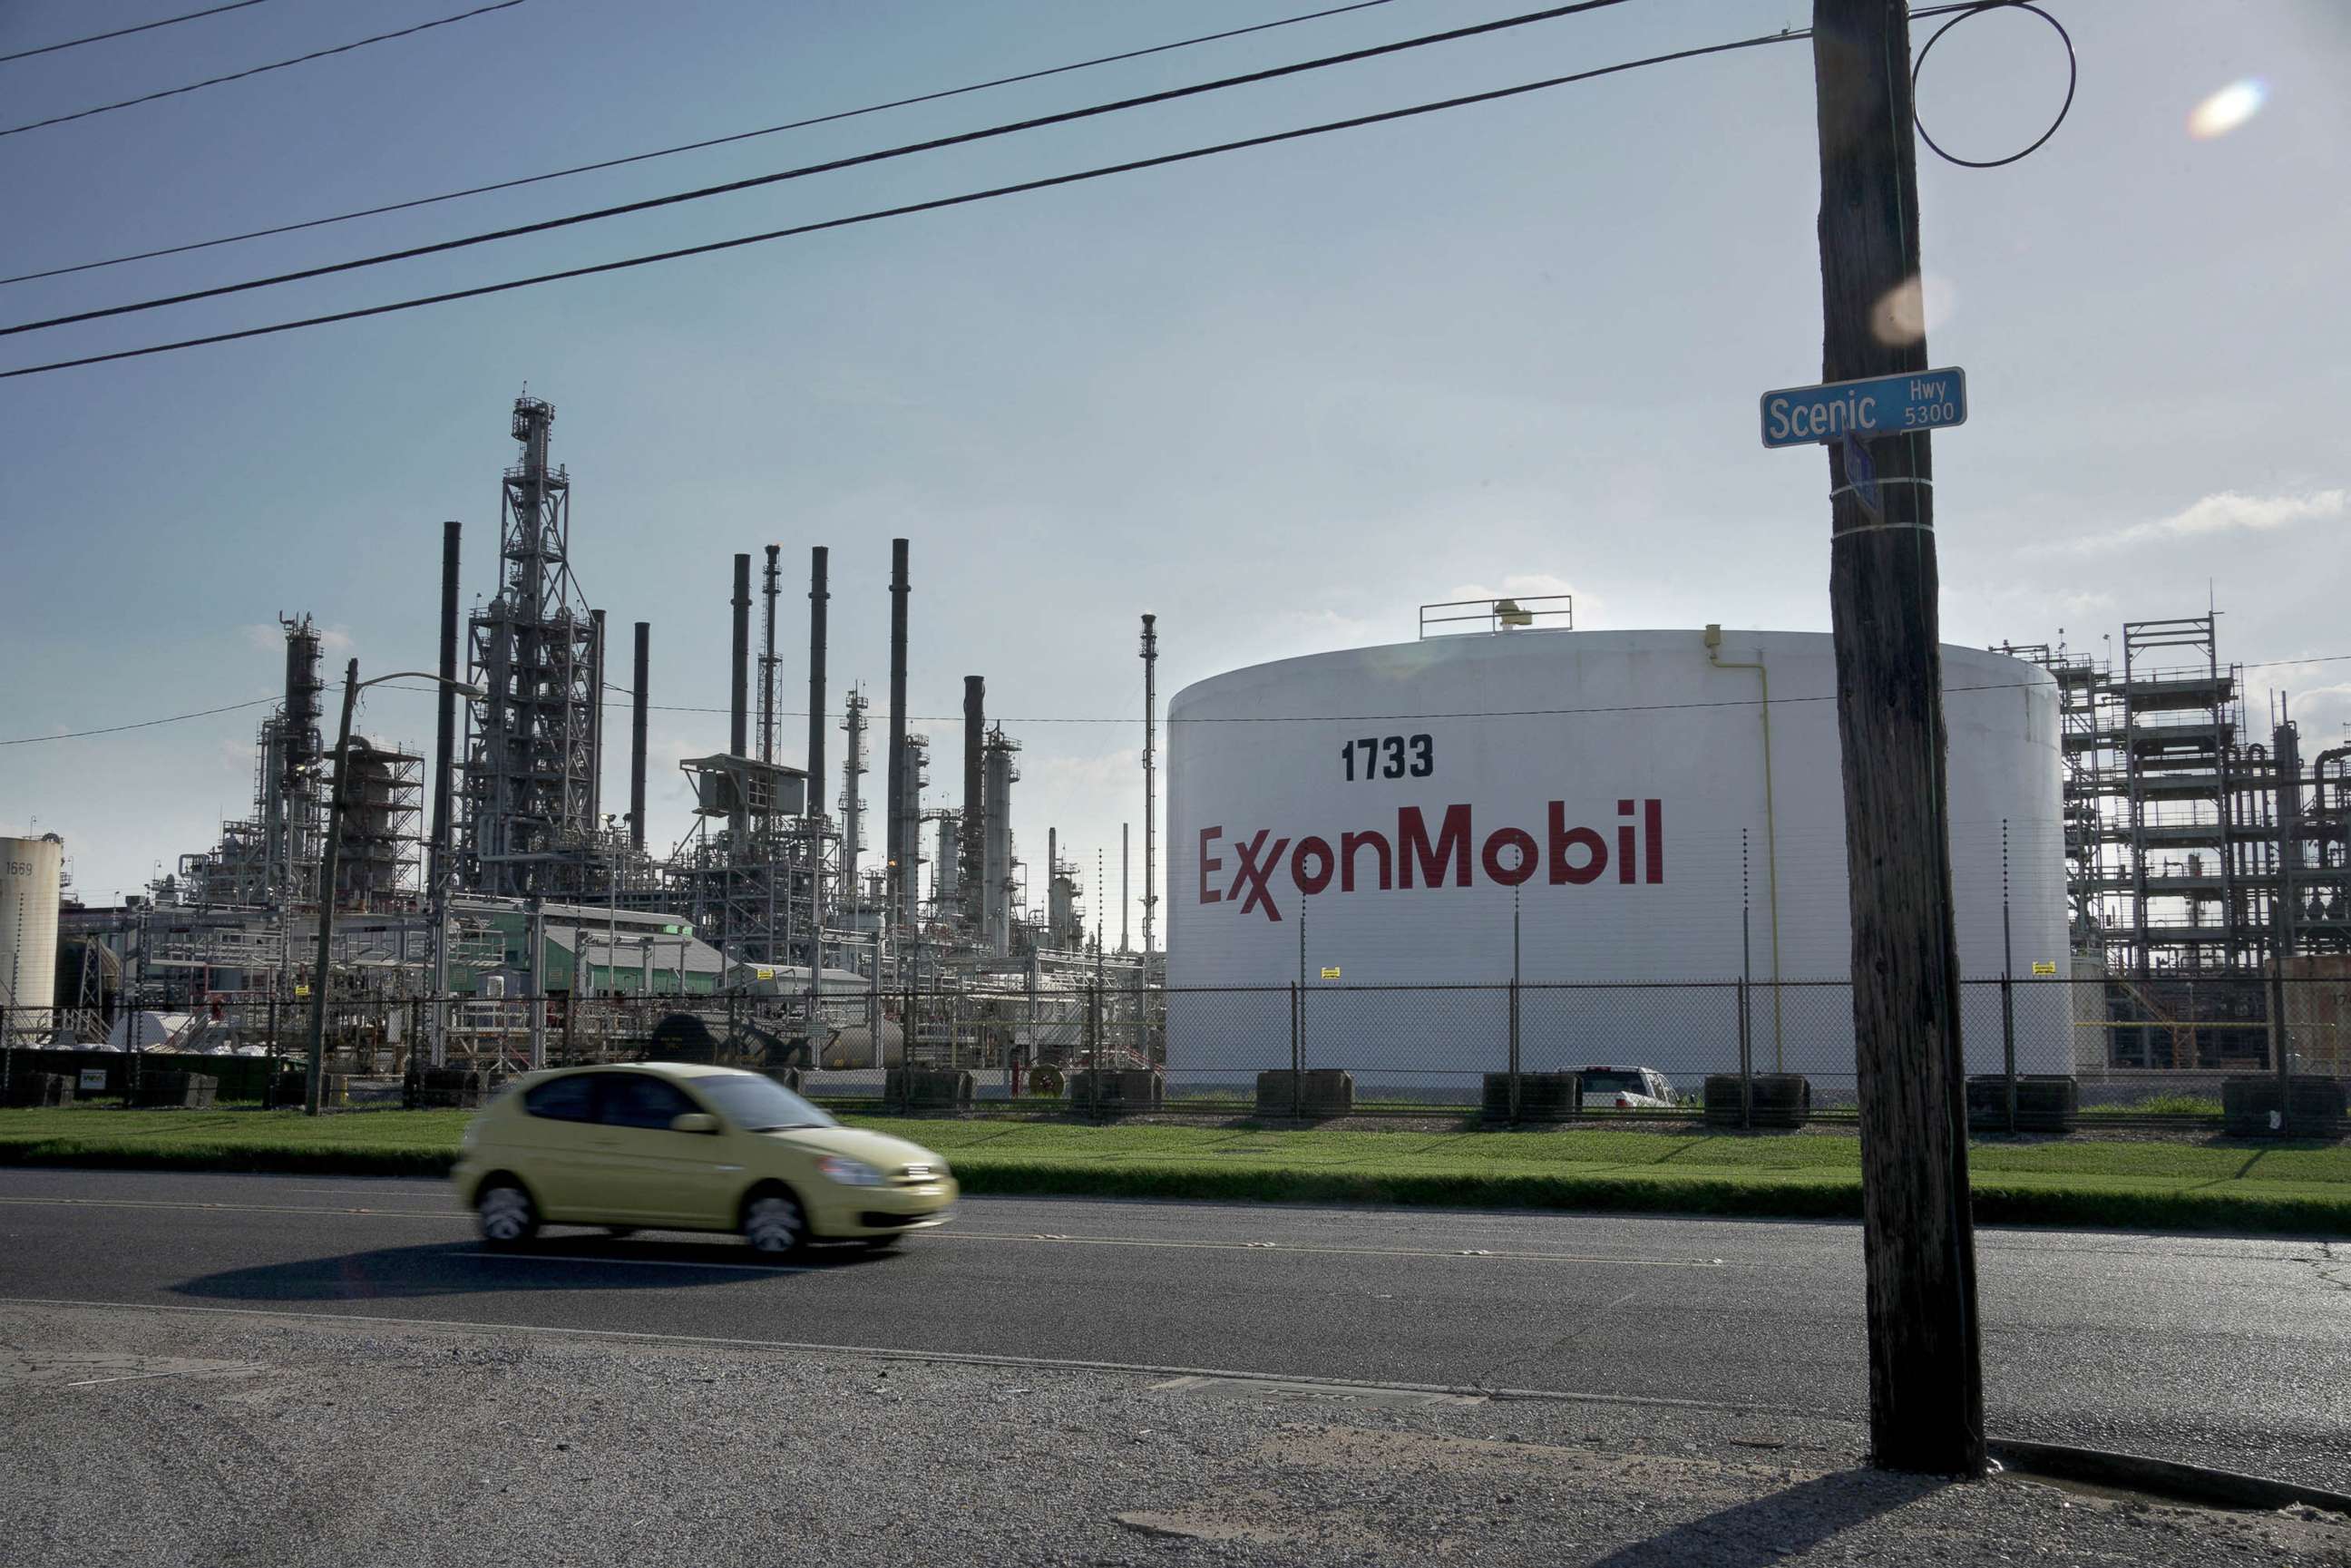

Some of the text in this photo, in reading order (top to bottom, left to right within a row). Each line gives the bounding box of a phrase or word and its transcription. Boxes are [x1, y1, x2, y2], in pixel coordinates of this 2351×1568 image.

[1770, 379, 1946, 439] Scenic Hwy
[1905, 402, 1955, 425] 5300
[1341, 734, 1433, 781] 1733
[6, 862, 33, 876] 1669
